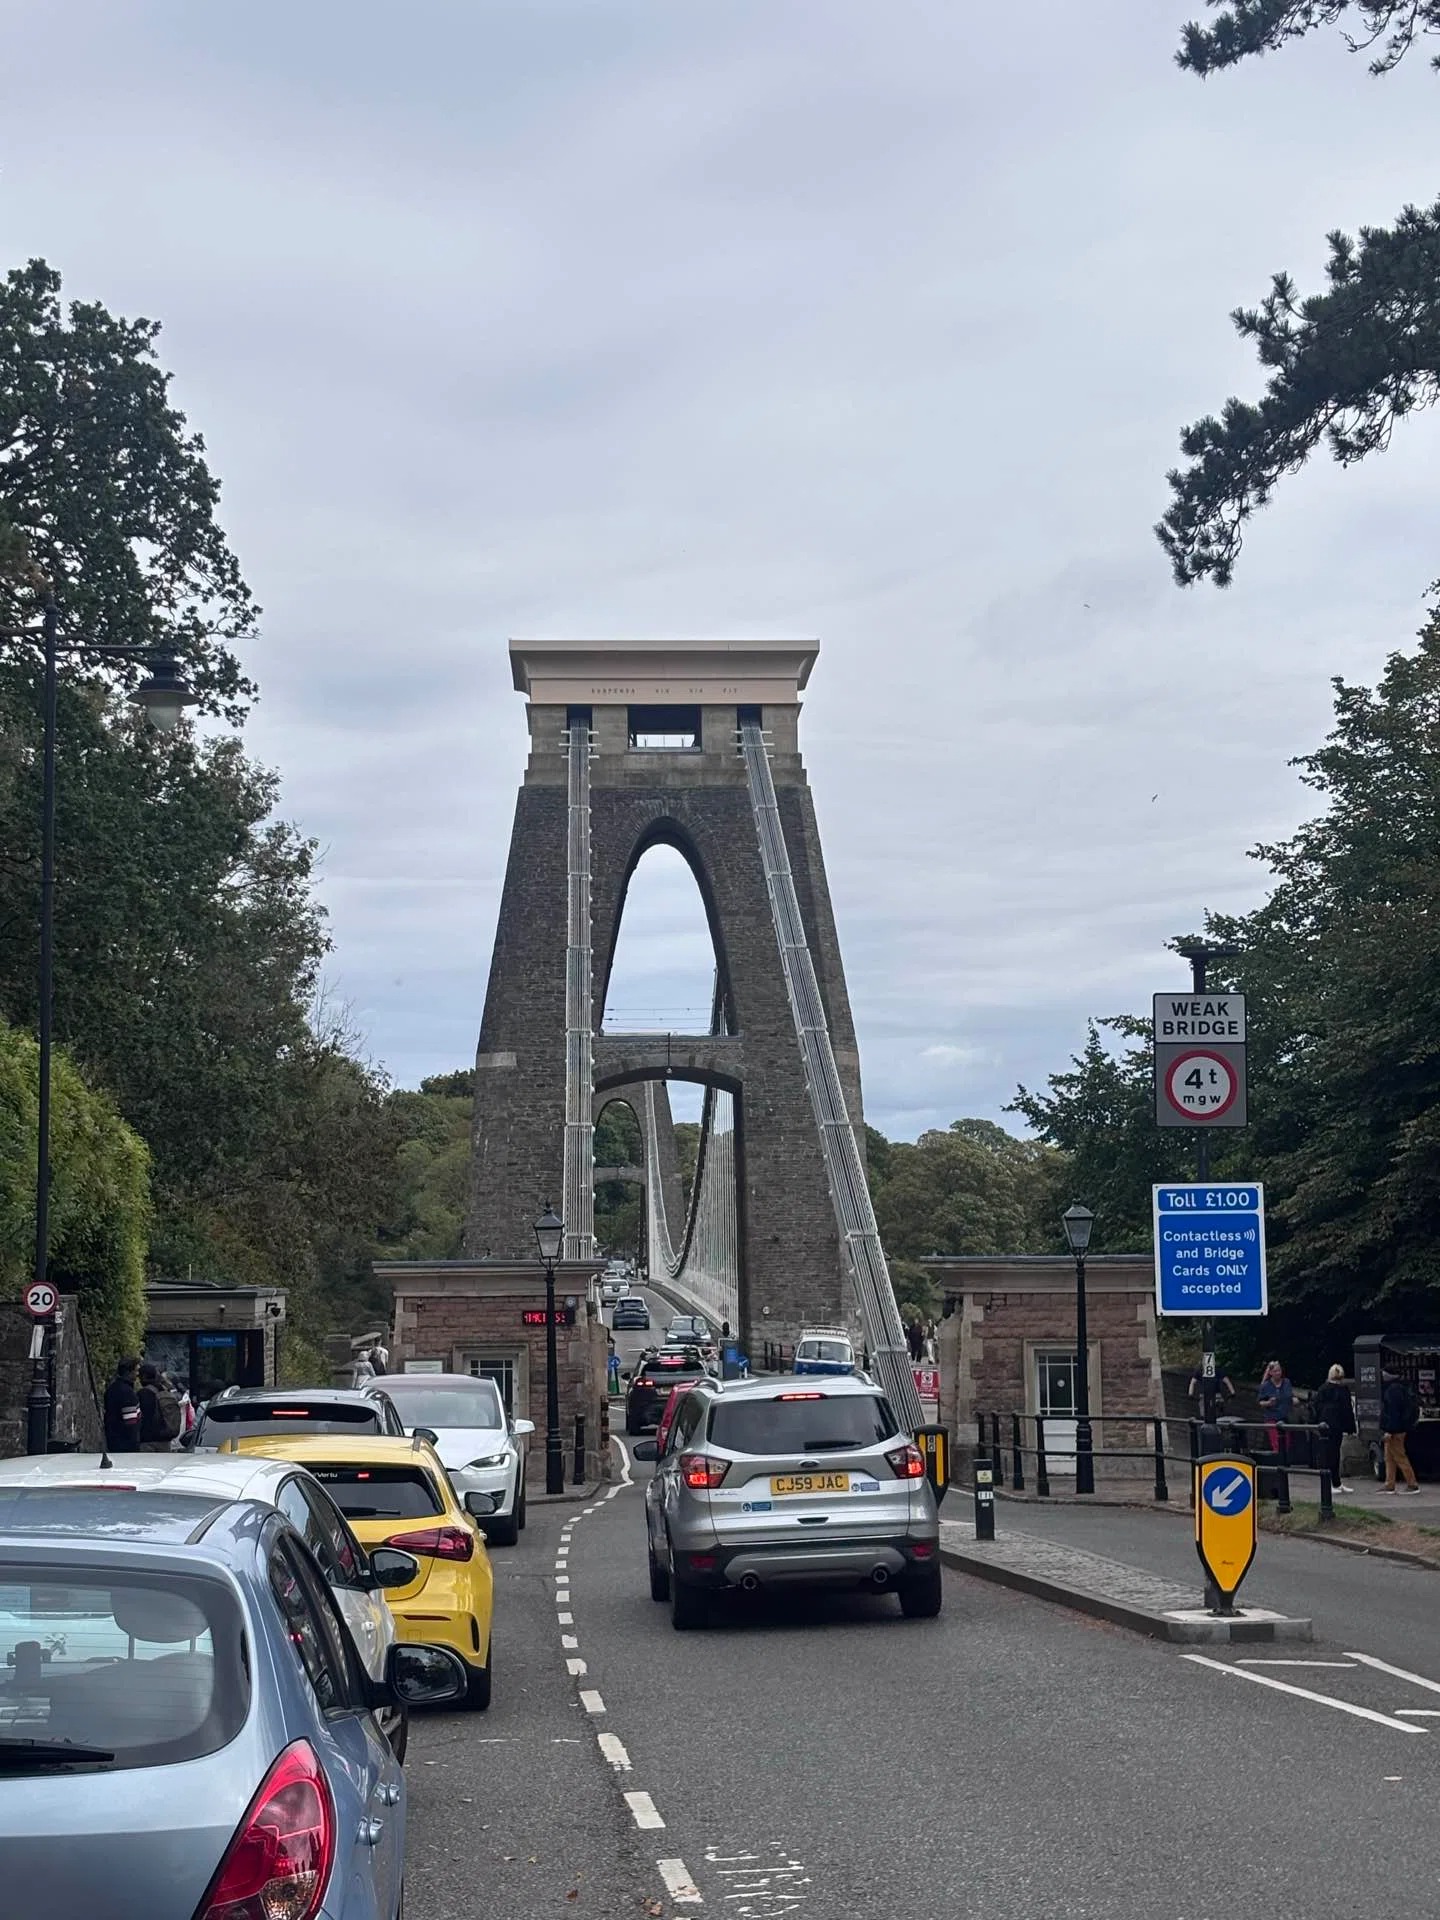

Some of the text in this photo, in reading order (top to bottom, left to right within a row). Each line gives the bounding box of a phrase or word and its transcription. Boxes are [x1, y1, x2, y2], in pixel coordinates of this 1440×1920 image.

[1172, 1002, 1229, 1017] WEAK
[1163, 1021, 1239, 1036] BRIDGE
[1166, 1191, 1250, 1208] Toll £1.00
[1163, 1230, 1242, 1242] Contactless
[1176, 1247, 1245, 1260] and Bridge
[1172, 1264, 1248, 1276] Cards ONLY
[1181, 1282, 1242, 1295] accepted
[30, 1292, 53, 1306] 20
[776, 1476, 813, 1492] CJ59
[817, 1475, 844, 1490] JAC
